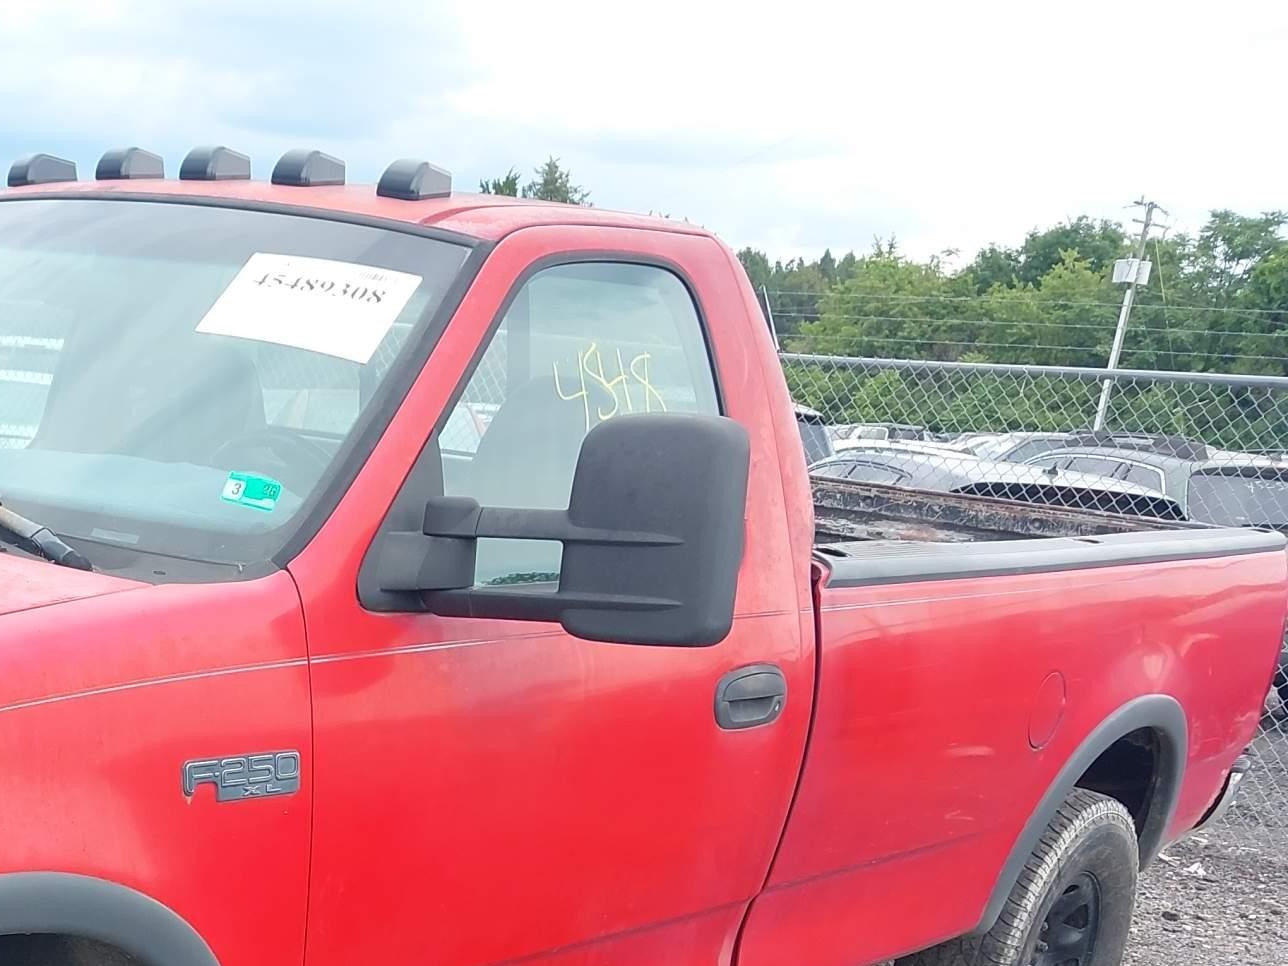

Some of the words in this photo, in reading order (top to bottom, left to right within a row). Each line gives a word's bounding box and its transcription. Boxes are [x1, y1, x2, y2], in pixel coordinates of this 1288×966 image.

[254, 272, 387, 303] 45489308
[231, 483, 242, 495] 3
[242, 784, 282, 796] XL
